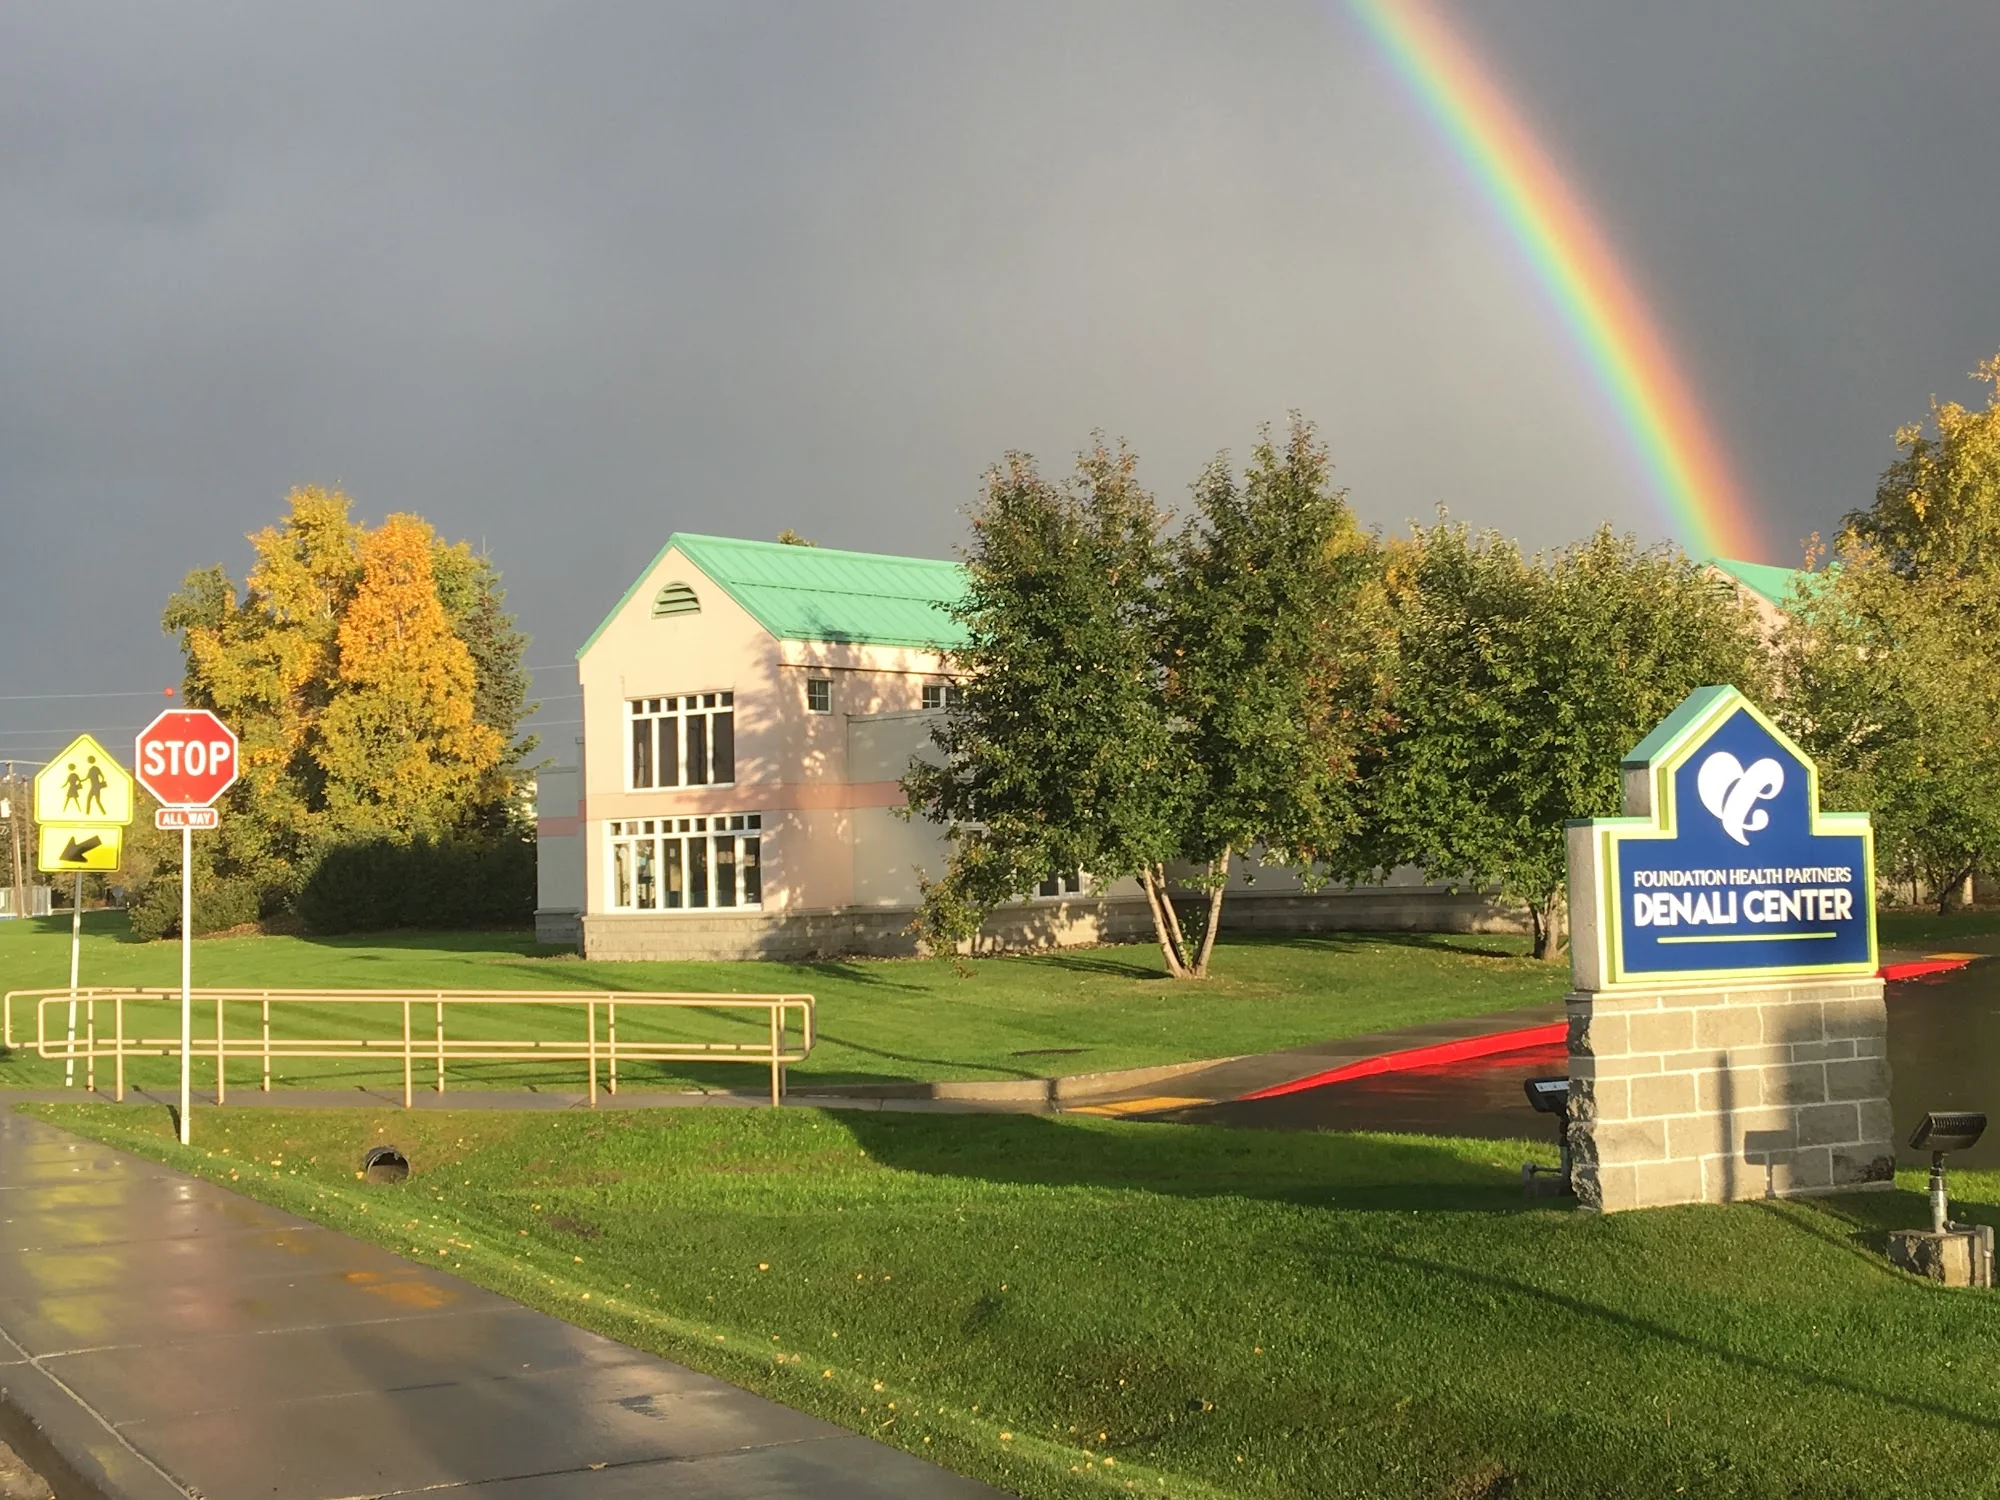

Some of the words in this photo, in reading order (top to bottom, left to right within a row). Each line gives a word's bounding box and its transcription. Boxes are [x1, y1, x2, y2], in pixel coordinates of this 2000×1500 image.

[144, 740, 230, 776] STOP
[162, 813, 184, 825] ALL
[188, 813, 211, 825] WAY
[1634, 869, 1727, 887] FOUNDATION
[1729, 868, 1782, 885] HEALTH
[1785, 867, 1852, 884] PARTNERS
[1633, 890, 1737, 926] DENALI
[1743, 888, 1853, 924] CENTER
